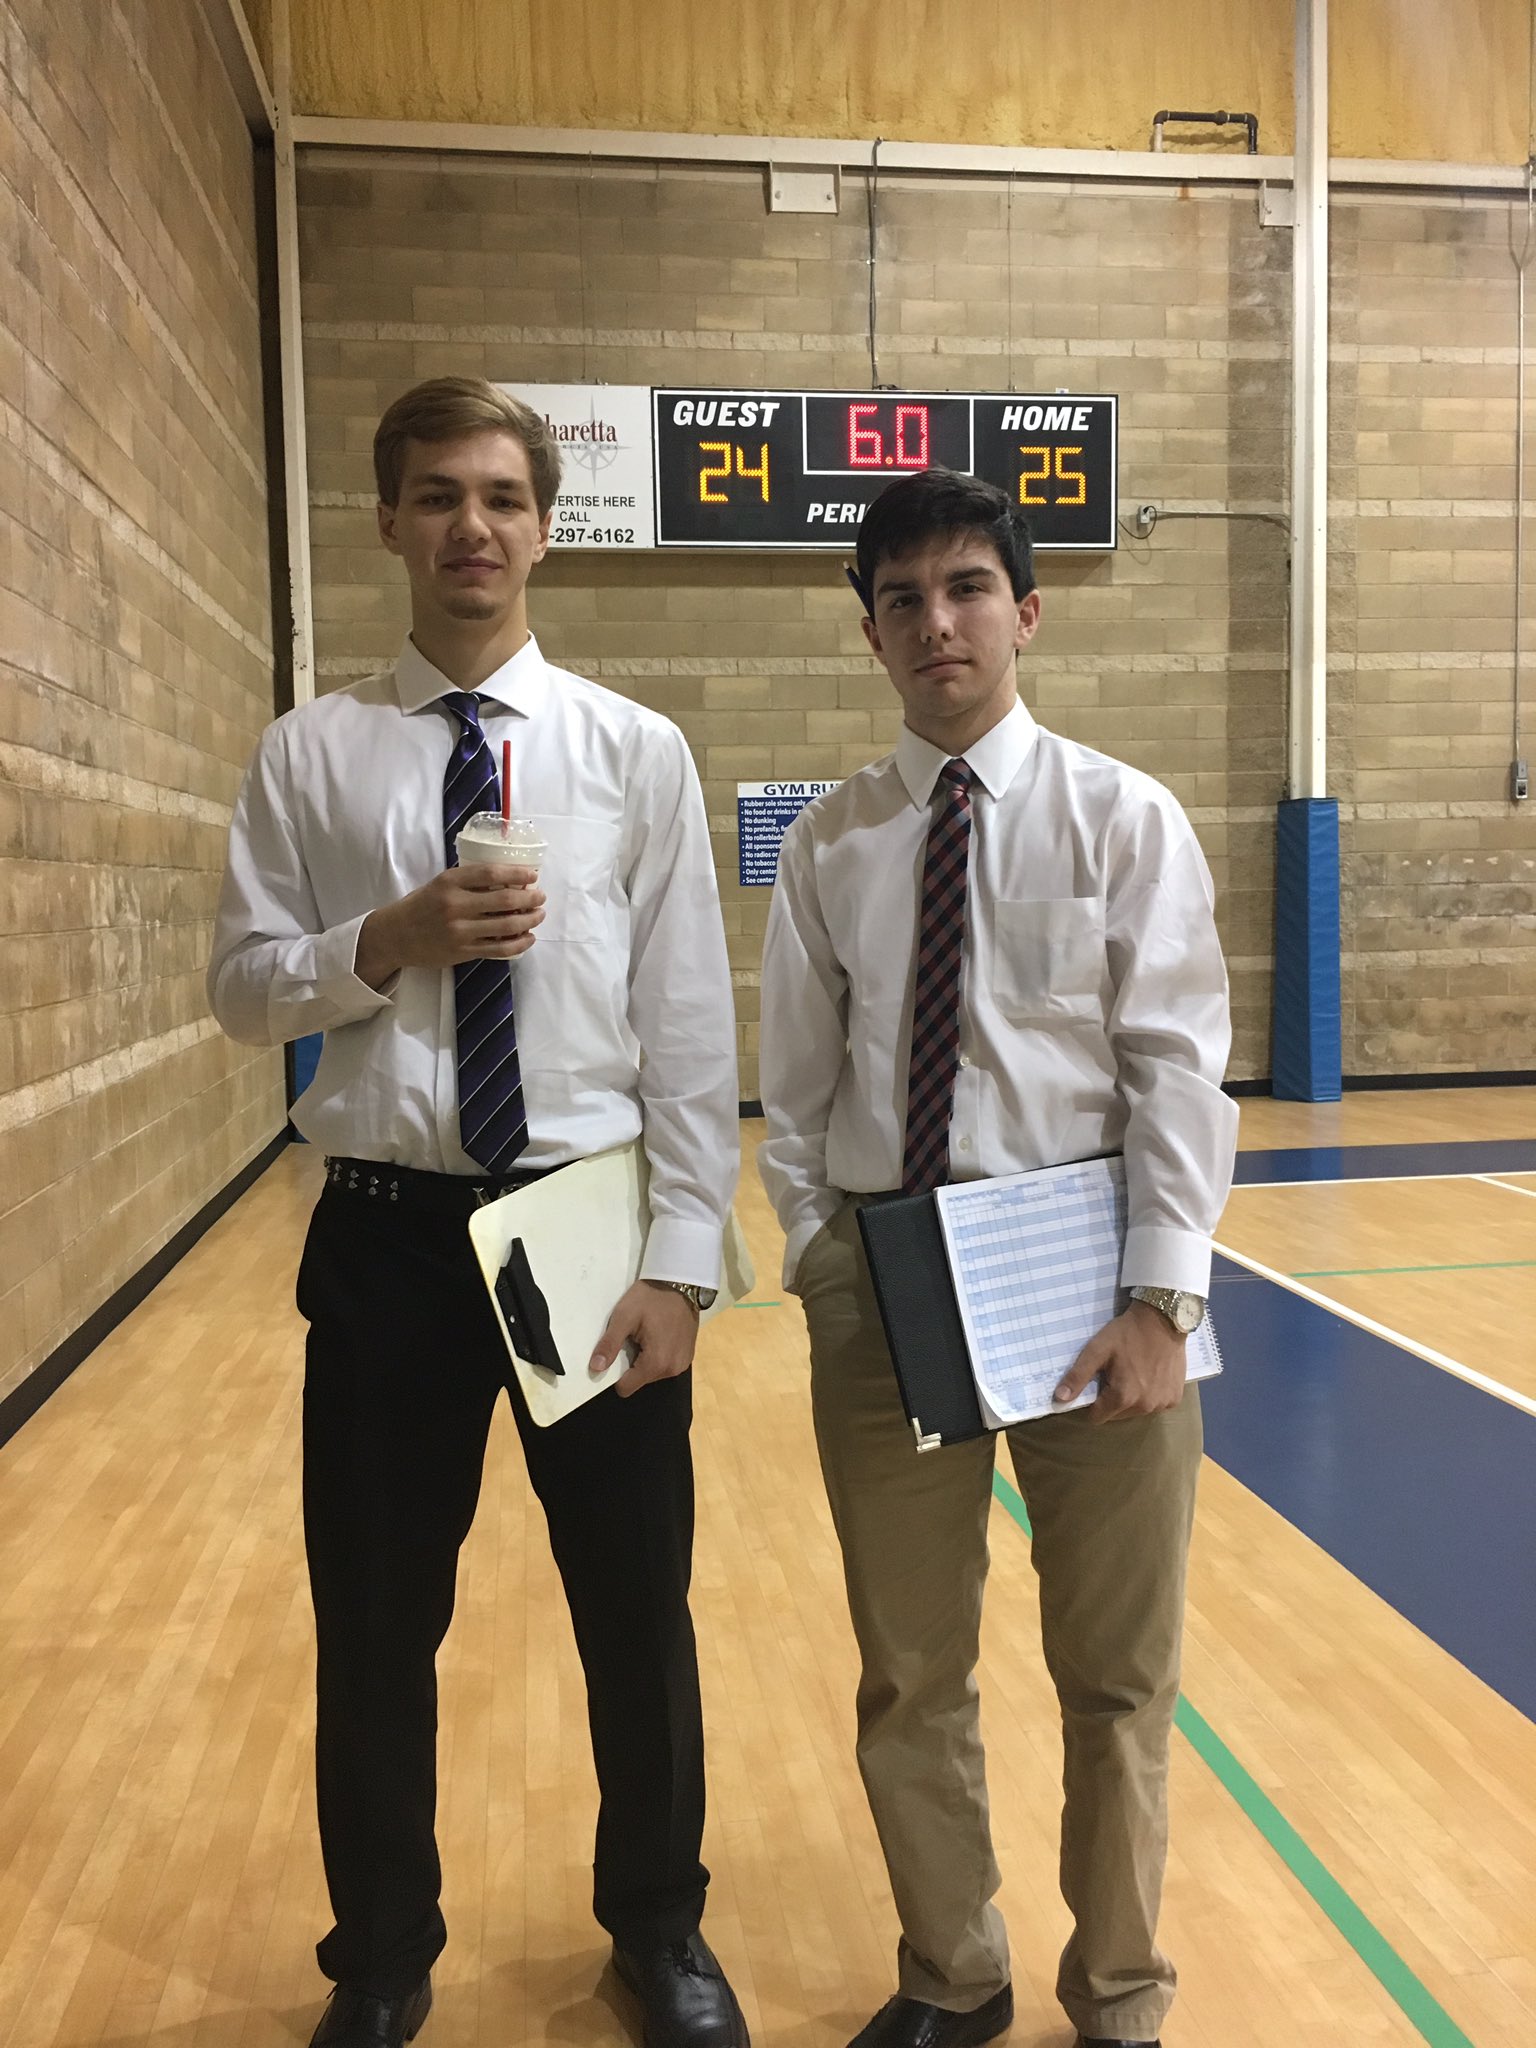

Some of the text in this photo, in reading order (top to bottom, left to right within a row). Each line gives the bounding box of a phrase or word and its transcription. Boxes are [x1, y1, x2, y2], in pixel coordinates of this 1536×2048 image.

[673, 400, 780, 428] GUEST
[1001, 406, 1093, 431] HOME
[544, 413, 617, 442] haretta
[848, 404, 929, 465] 6.0
[698, 442, 771, 504] 24
[1019, 446, 1087, 505] 25
[604, 496, 636, 507] HERE
[806, 503, 872, 523] PERI
[560, 511, 591, 522] CALL
[549, 528, 634, 543] -297-6162
[764, 784, 839, 795] GYM RU
